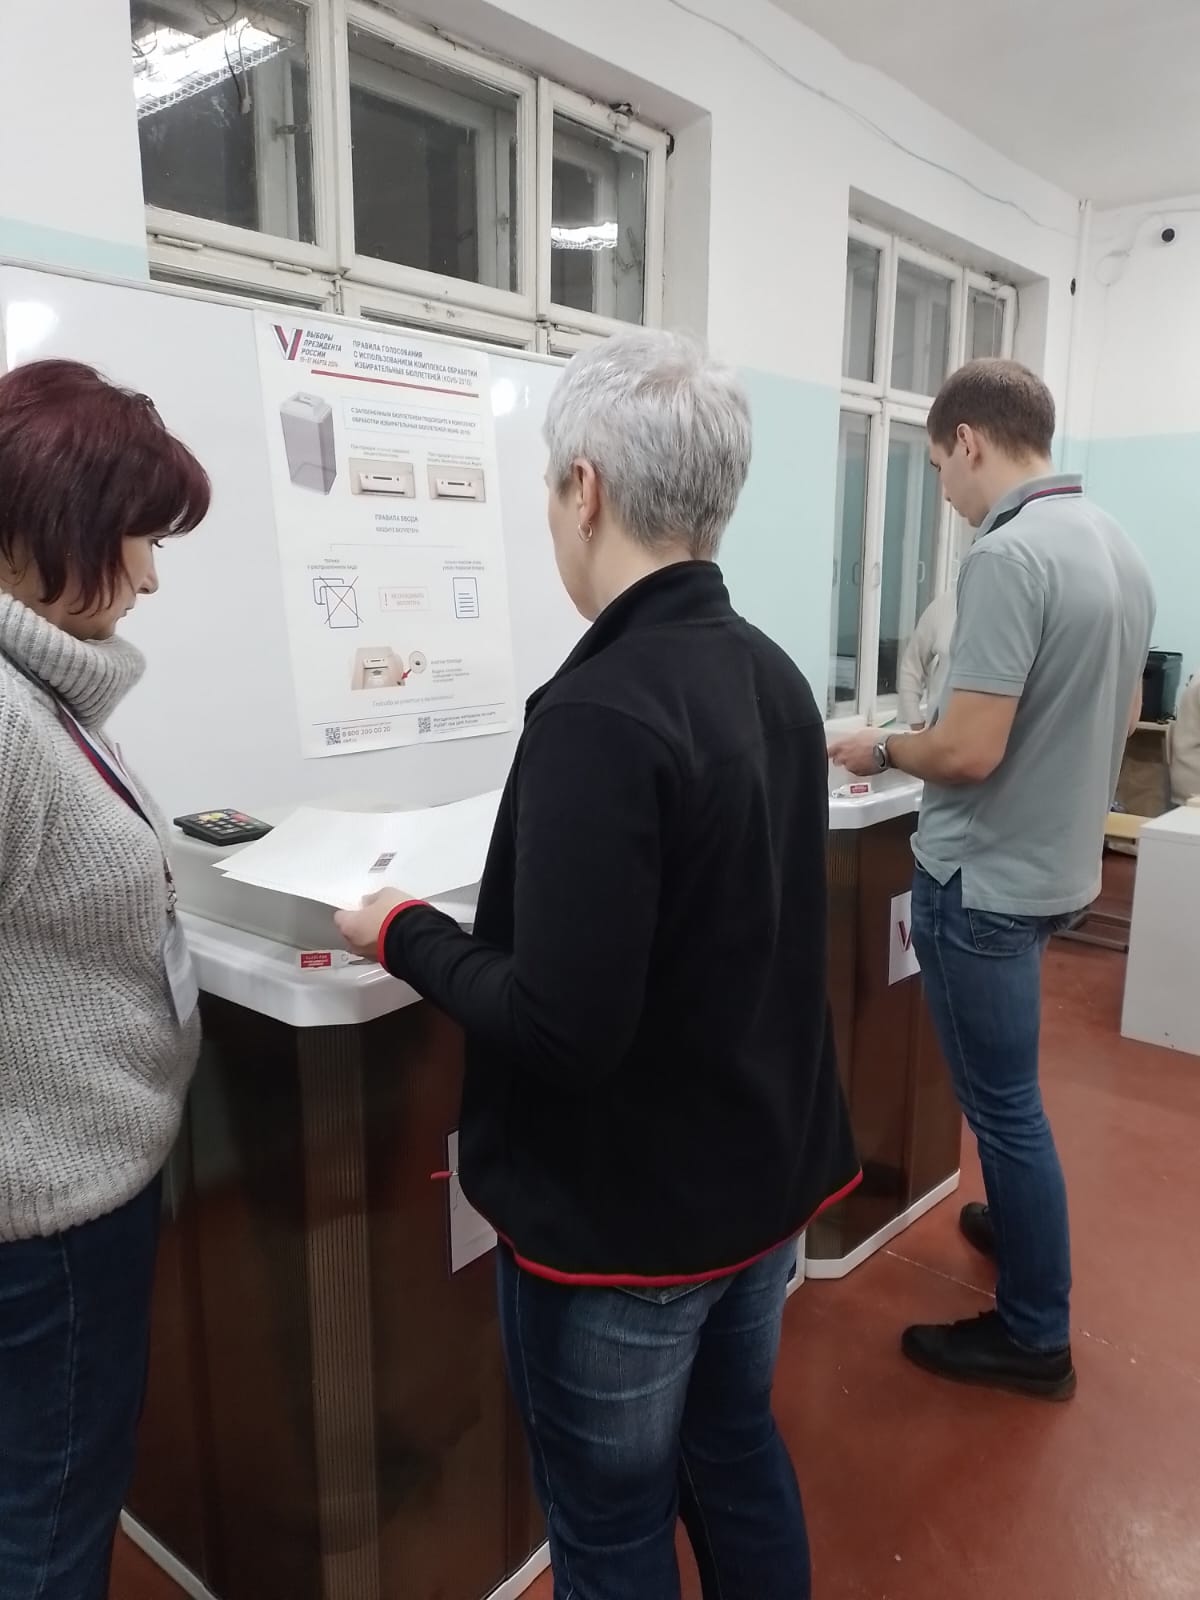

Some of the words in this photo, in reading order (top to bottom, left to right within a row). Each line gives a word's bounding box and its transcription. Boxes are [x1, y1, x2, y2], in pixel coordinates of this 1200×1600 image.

[306, 330, 335, 341] ВЫБОРЫ
[301, 348, 327, 358] РОССИИ
[303, 339, 342, 352] ПРЕЗИДЕНТА
[352, 340, 381, 352] ПРАВИЛА
[381, 345, 423, 358] ГОЛОСОВАНИЯ
[354, 361, 405, 375] ИЗБИРАТЕЛЬНЫХ
[405, 368, 441, 382] БЮЛЛЕТЕНЕЙ
[359, 351, 413, 367] ИСПОЛЬЗОВАНИЕМ
[413, 361, 447, 372] КОМПЛЕКСА
[447, 366, 478, 378] ОБРАБОТКИ
